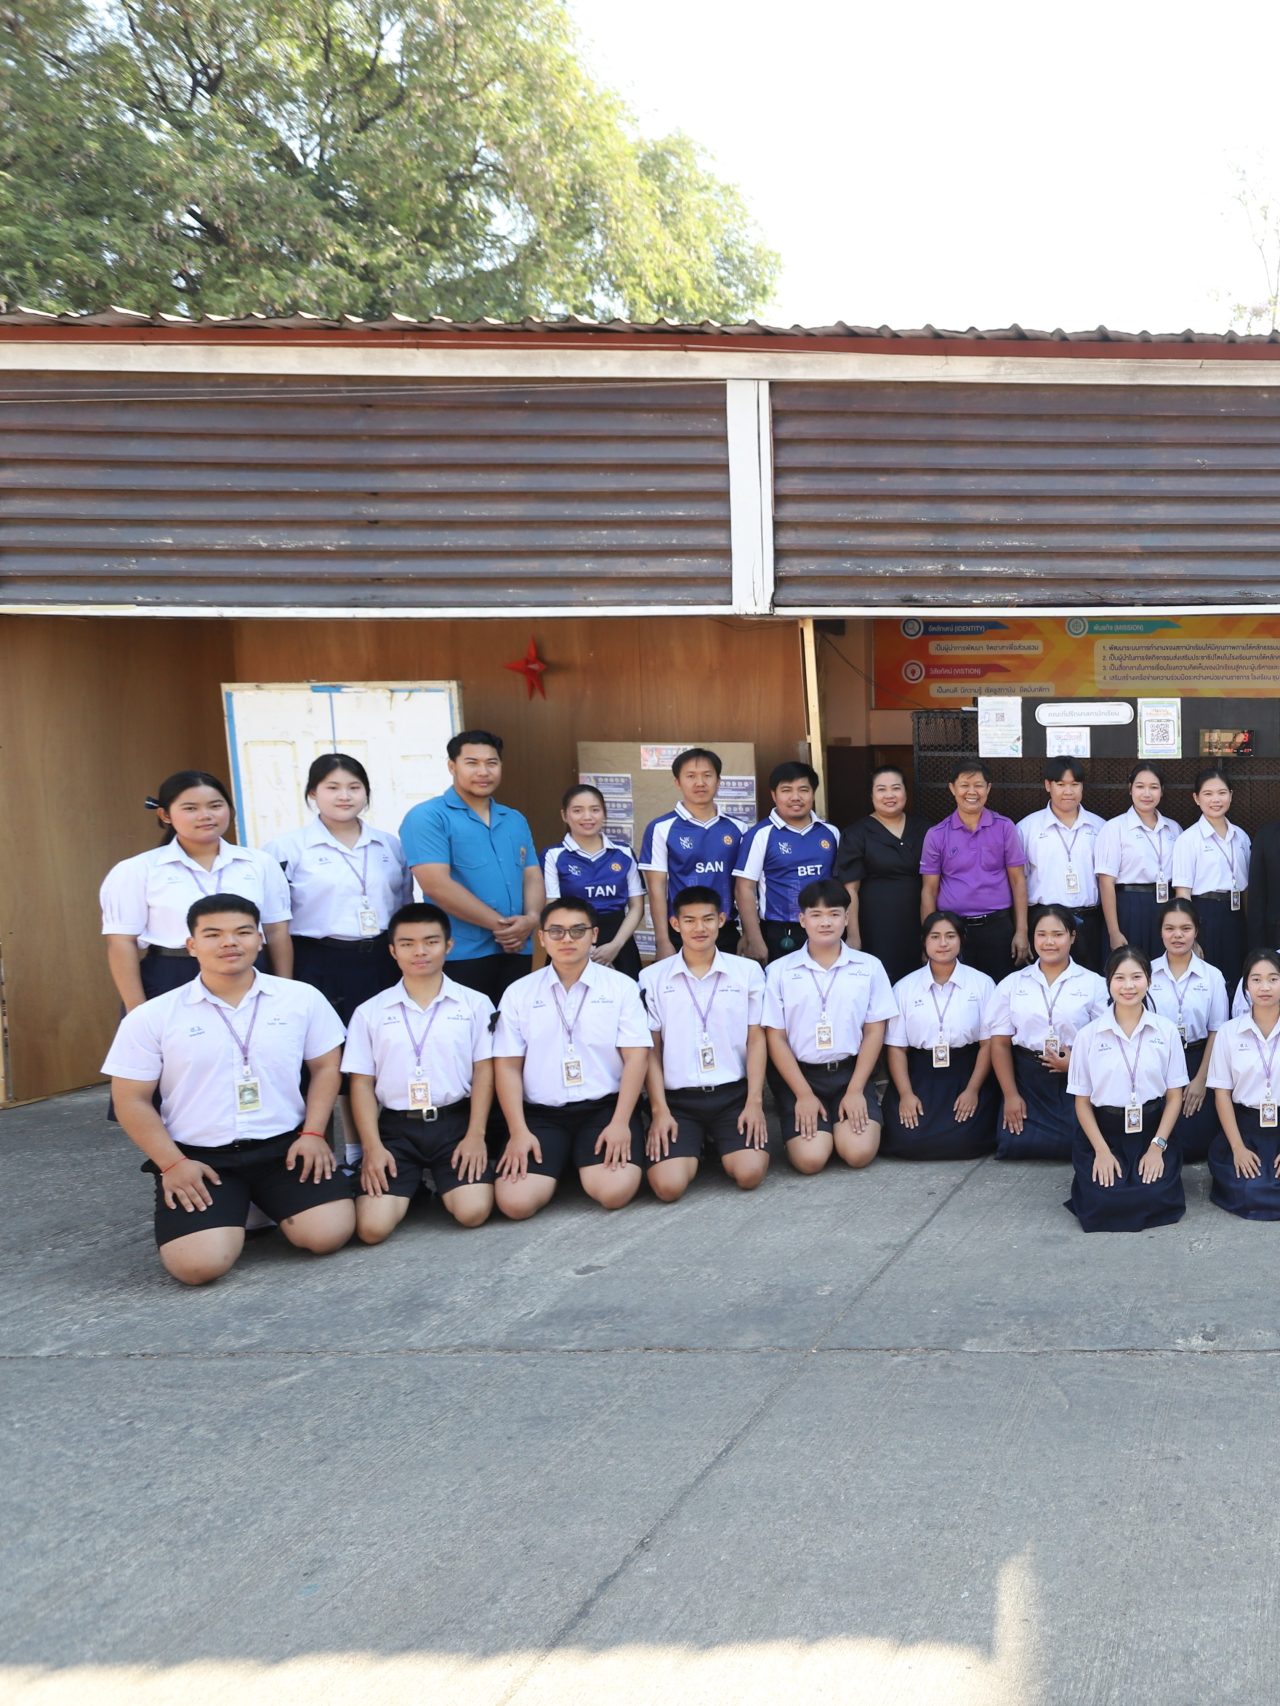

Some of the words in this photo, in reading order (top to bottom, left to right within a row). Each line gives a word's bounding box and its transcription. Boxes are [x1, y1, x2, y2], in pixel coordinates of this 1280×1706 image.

[954, 624, 985, 633] (IDENTITY)
[1114, 623, 1144, 632] (MISSION)
[695, 860, 724, 874] SAN
[797, 864, 823, 877] BET
[584, 884, 616, 898] TAN
